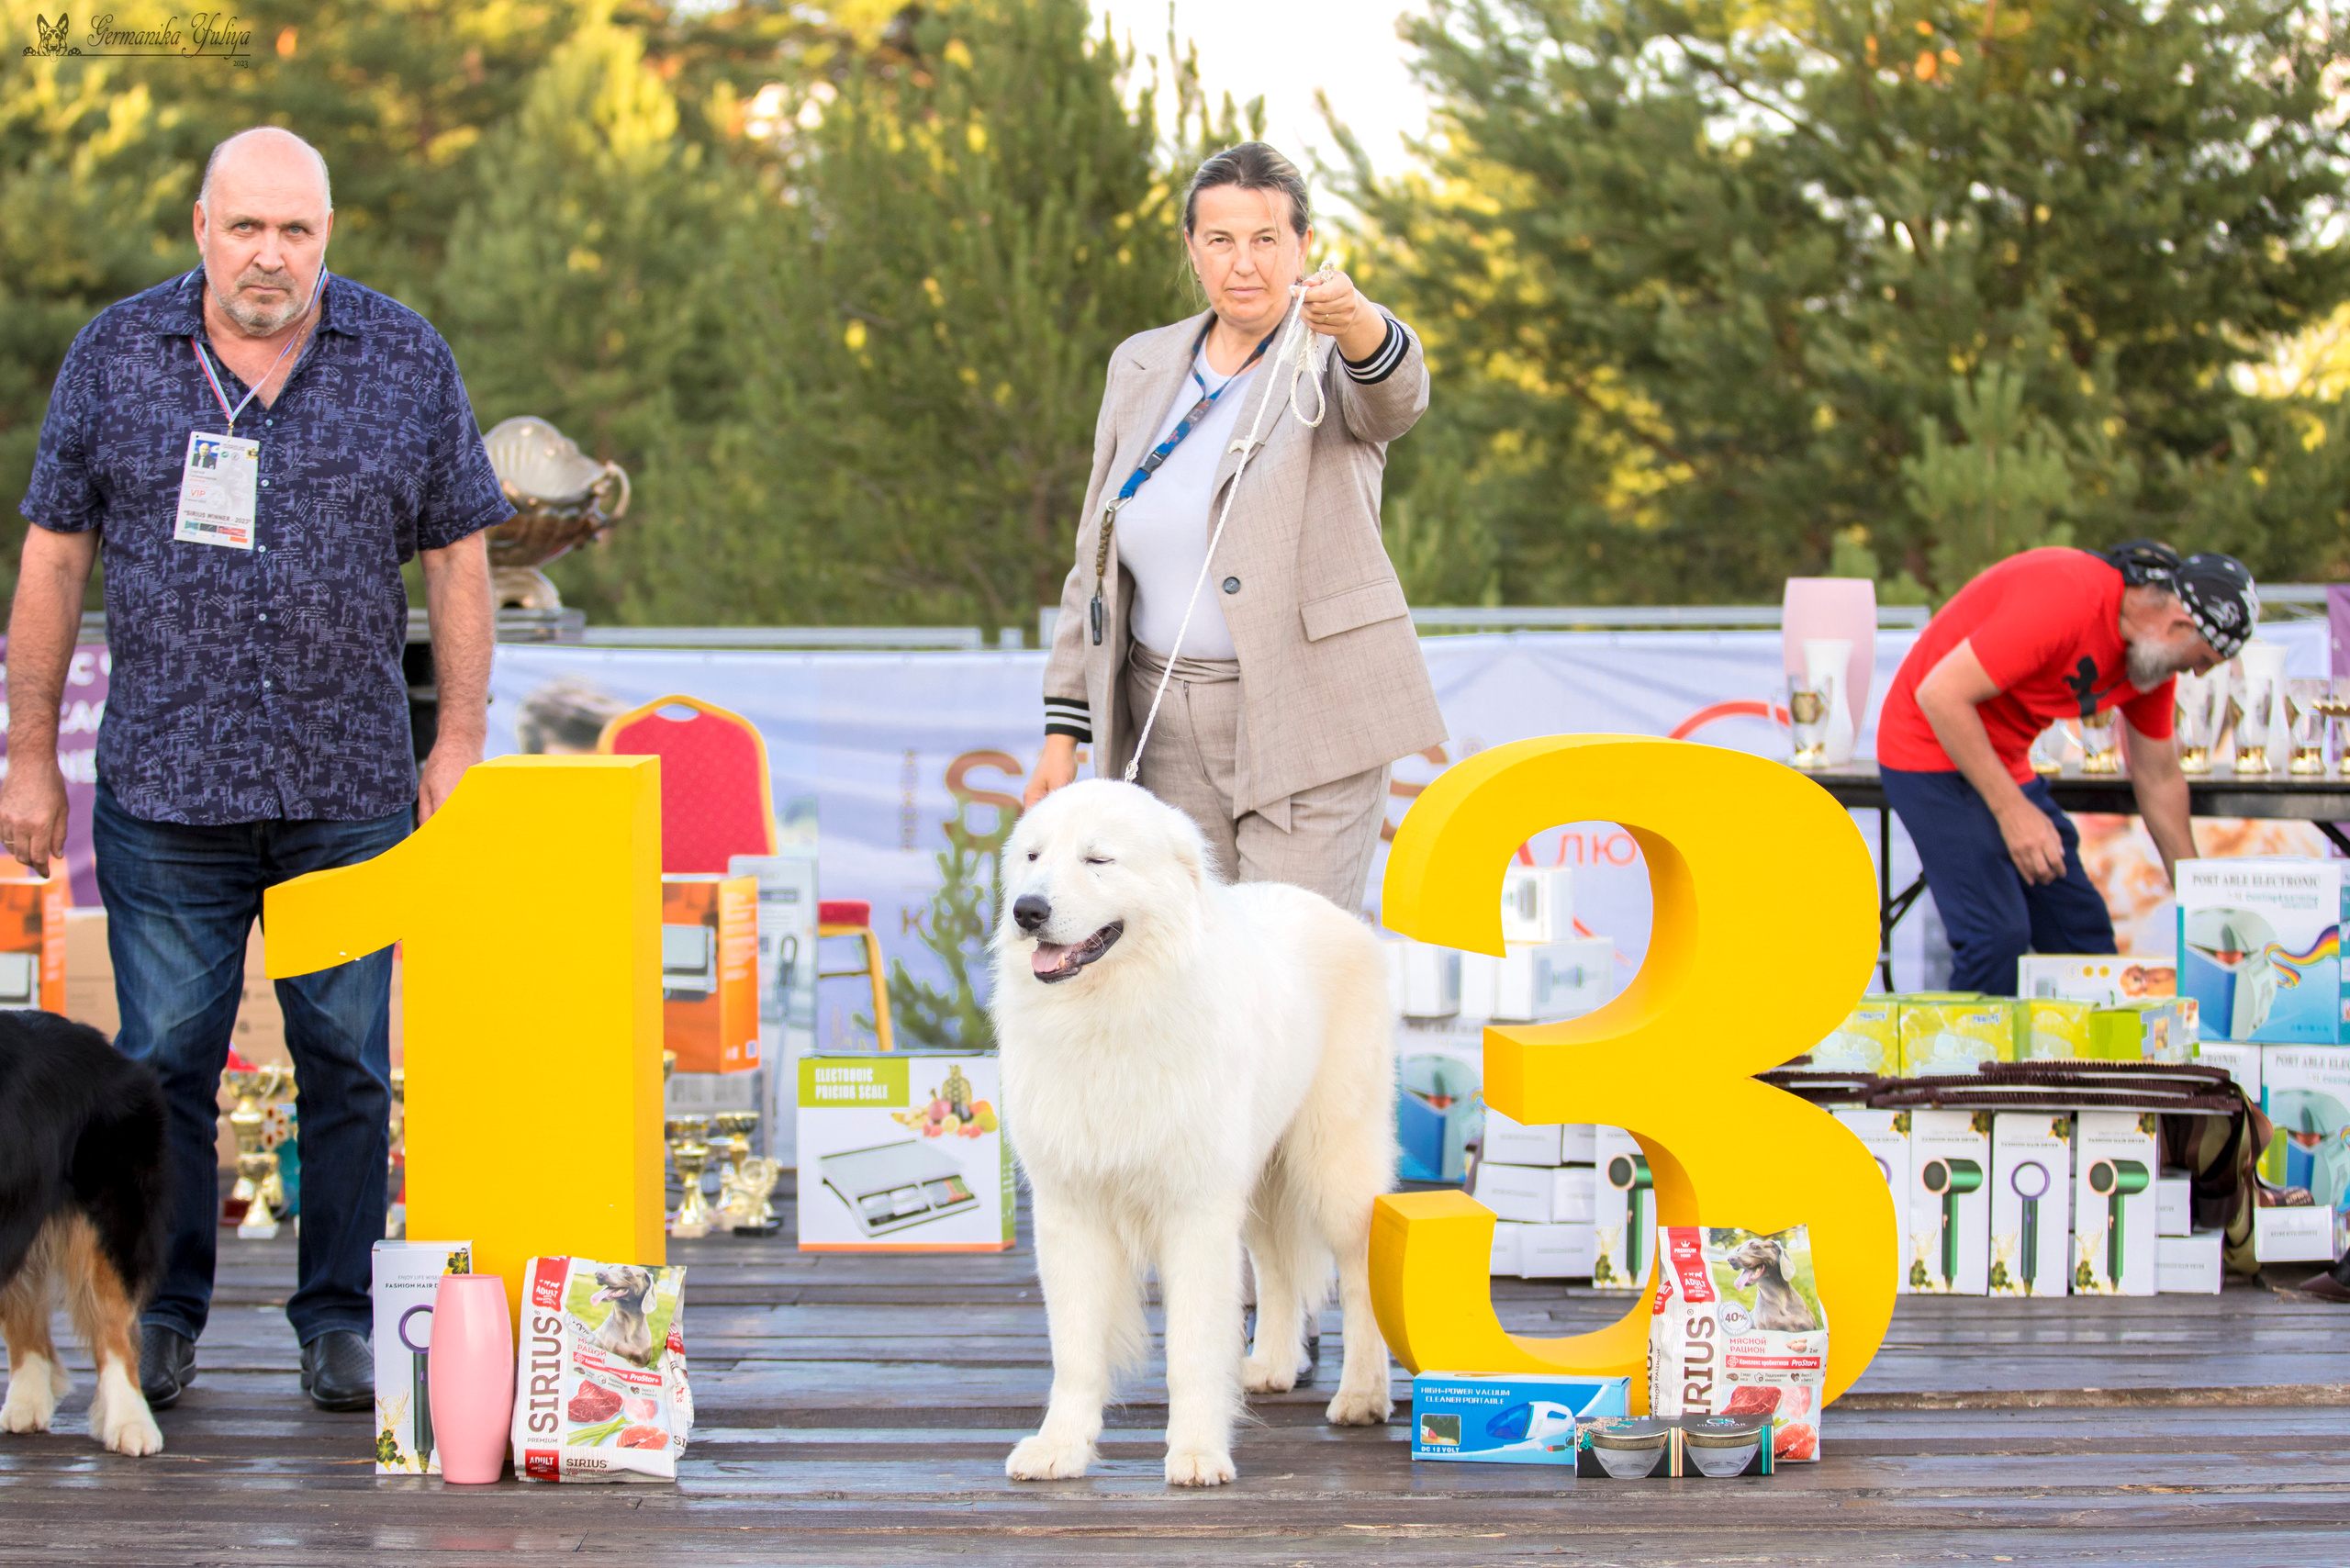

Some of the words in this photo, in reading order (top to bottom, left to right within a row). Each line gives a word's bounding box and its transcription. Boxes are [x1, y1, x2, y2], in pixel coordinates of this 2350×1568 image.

[190, 488, 207, 498] VIP
[207, 513, 230, 521] WINNER
[2252, 875, 2321, 888] ELECTRONIC
[815, 1068, 874, 1082] ELECTRONIC
[858, 1084, 889, 1100] SCALE
[1684, 1278, 1707, 1288] ADULT
[535, 1285, 559, 1298] ADULT
[1724, 1311, 1747, 1323] 40%
[1729, 1337, 1767, 1346] МЯСНОЙ
[1729, 1346, 1765, 1355] РАЦИОН
[1681, 1316, 1716, 1416] IRIUS
[1762, 1359, 1789, 1367] пробиотиков
[1791, 1359, 1818, 1367] ProStor+
[528, 1316, 563, 1434] SIRIUS
[629, 1372, 660, 1384] ProStor+
[1420, 1386, 1473, 1395] HIGH-POWER
[1475, 1388, 1511, 1396] VACUUM
[1425, 1395, 1461, 1404] CLEANER
[1462, 1396, 1505, 1405] PORTABLE
[529, 1456, 554, 1466] ADULT
[565, 1458, 608, 1469] SIRIUS
